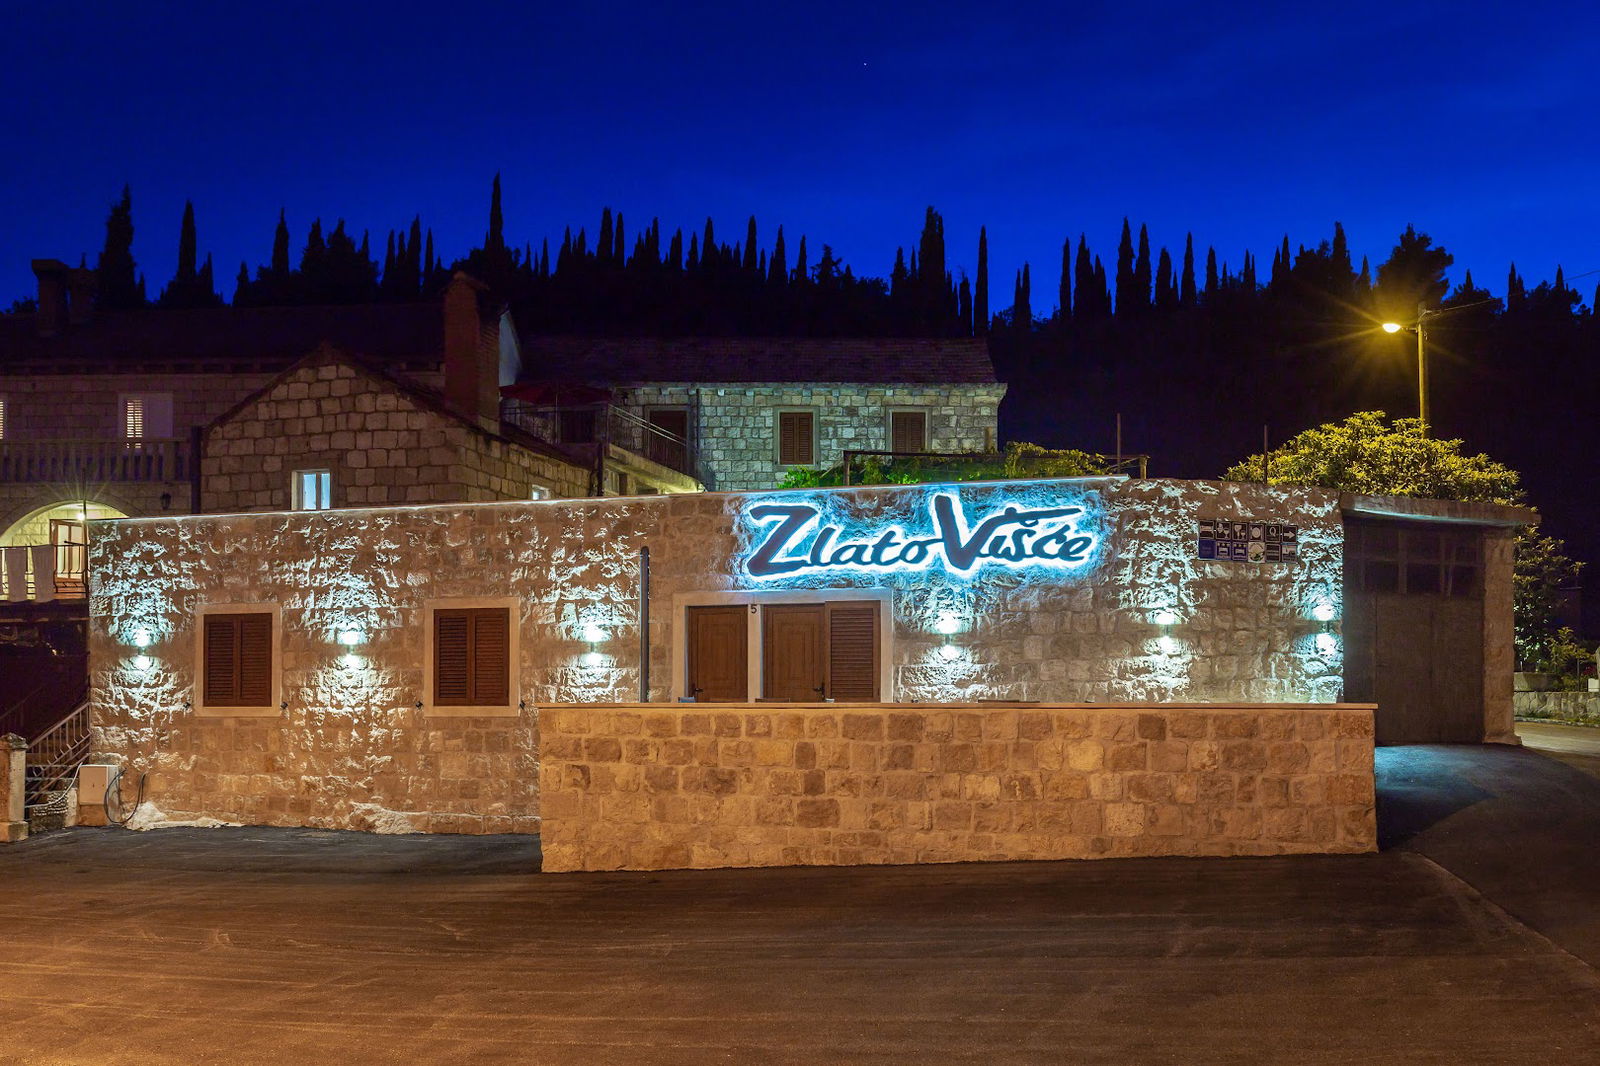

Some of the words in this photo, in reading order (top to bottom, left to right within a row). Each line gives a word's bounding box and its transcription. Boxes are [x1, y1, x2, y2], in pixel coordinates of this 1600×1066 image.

[1269, 526, 1277, 537] Q
[747, 504, 931, 577] Zlato
[750, 604, 758, 614] 5
